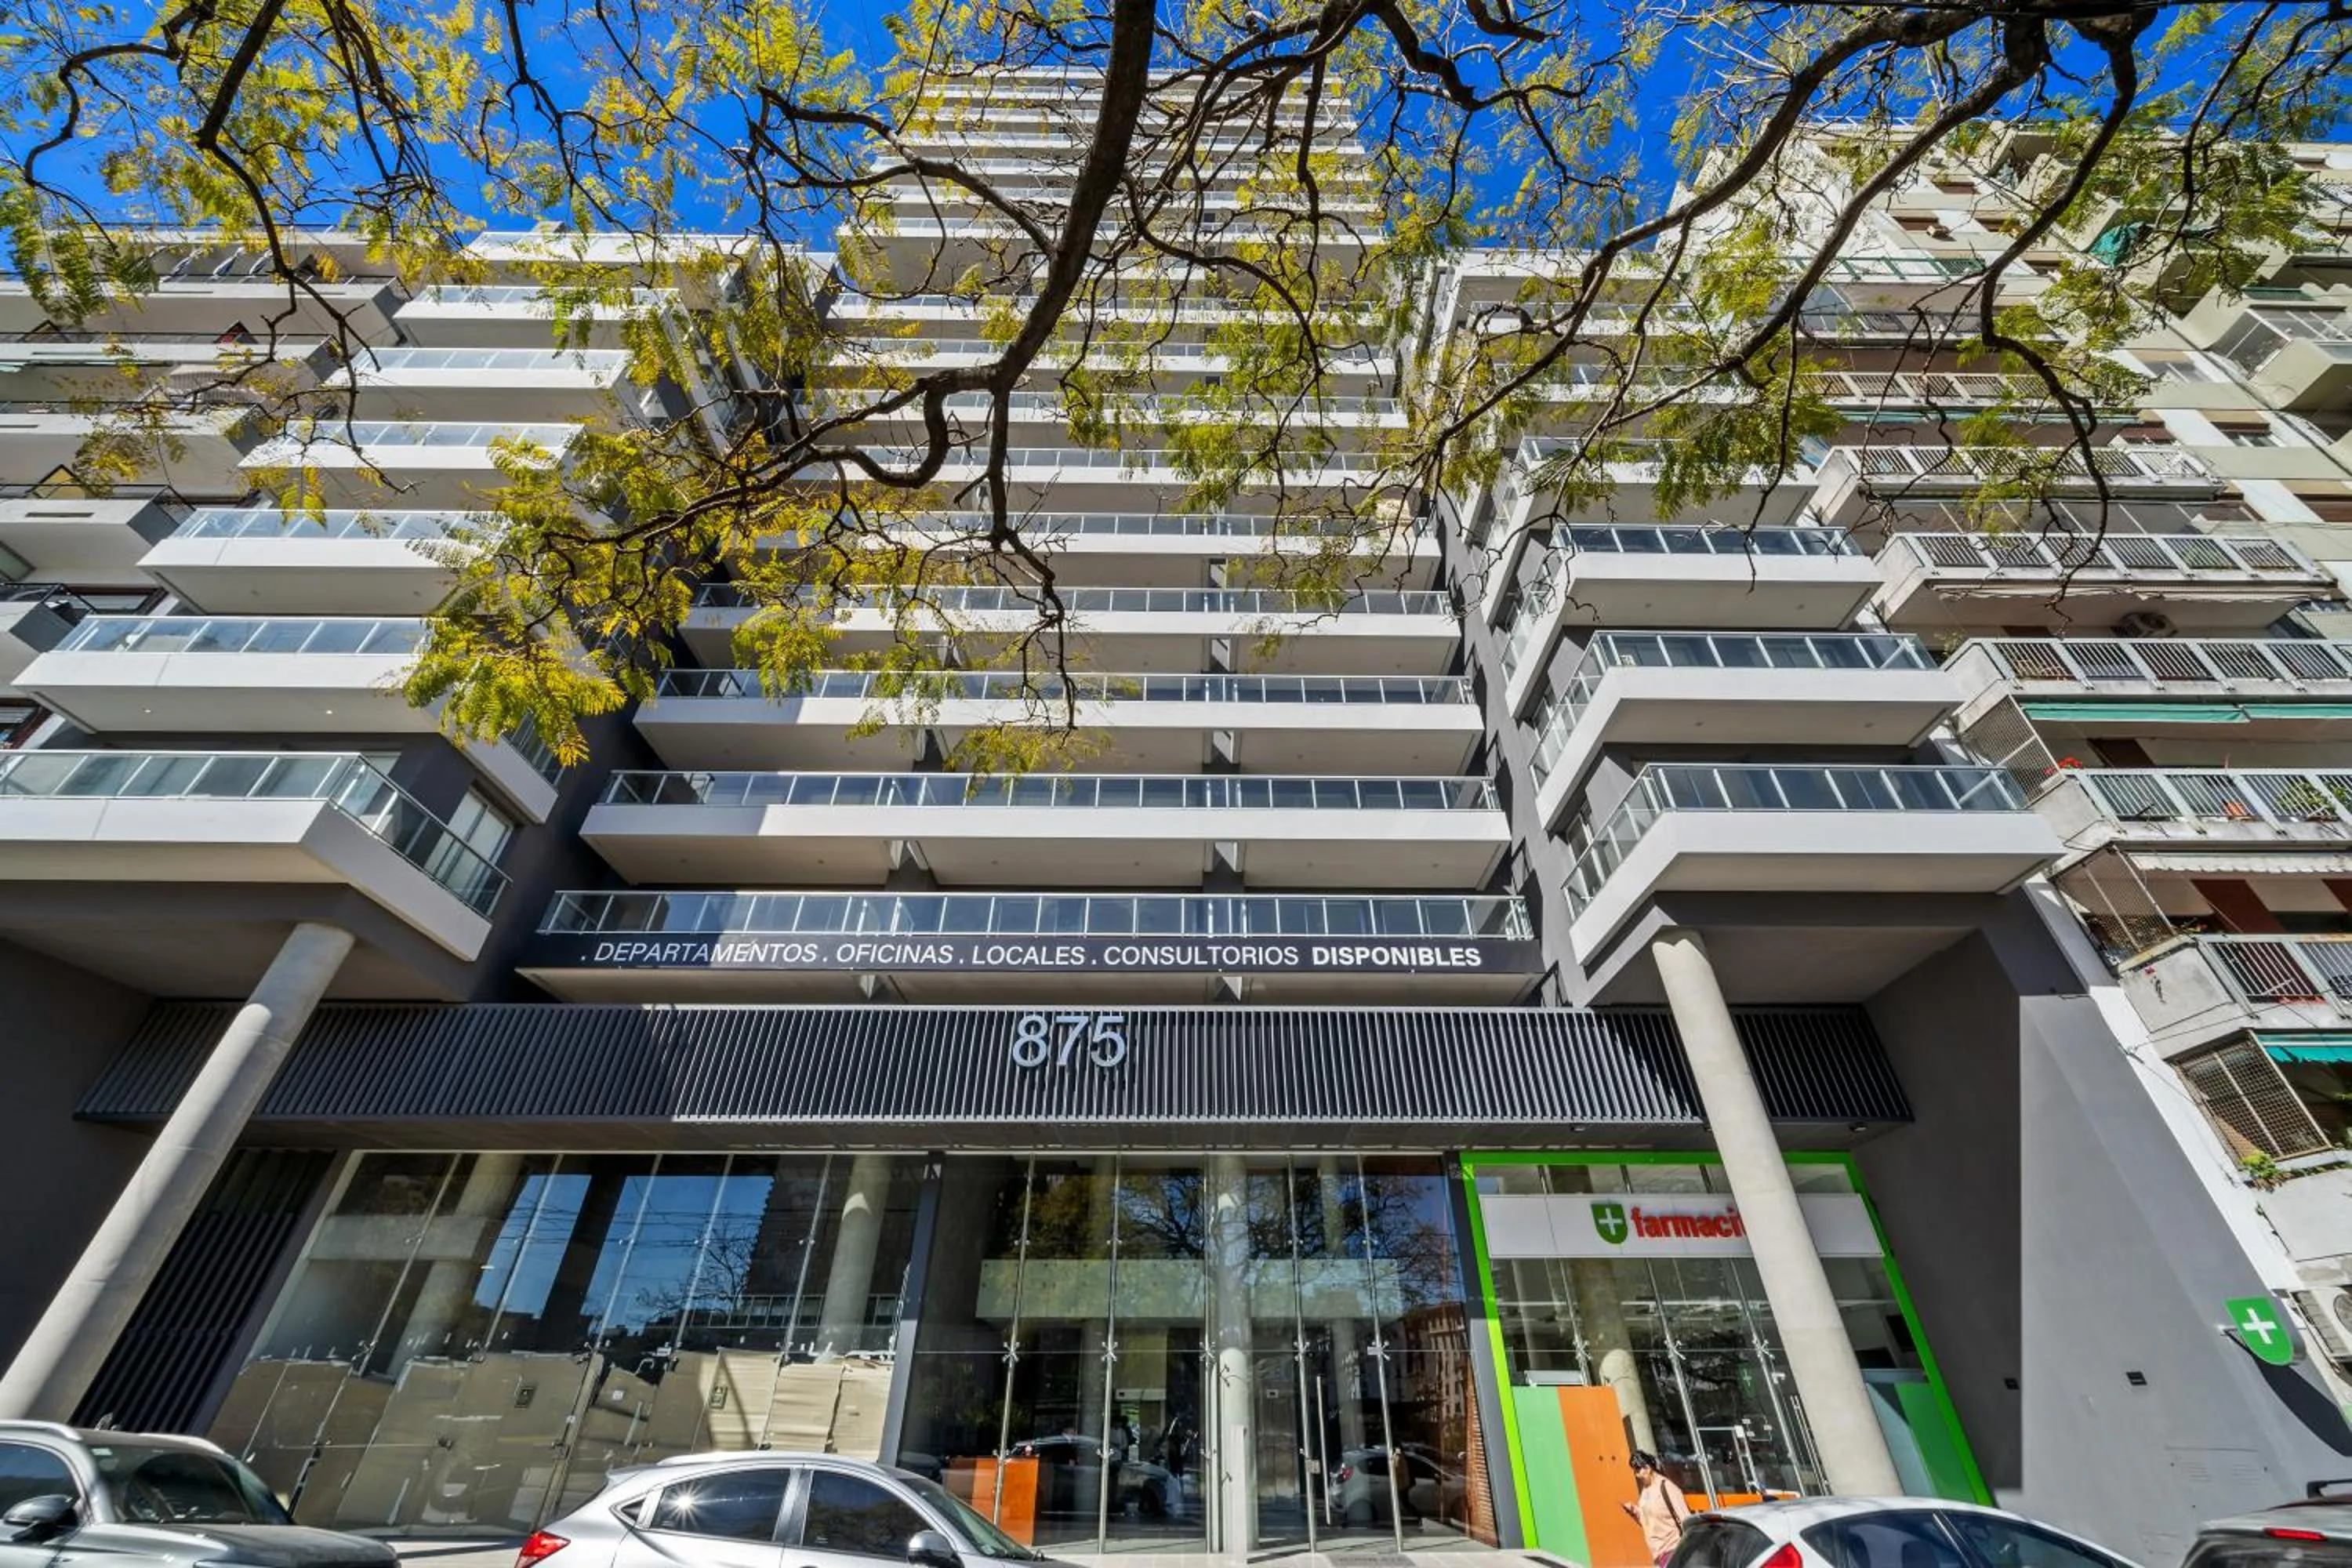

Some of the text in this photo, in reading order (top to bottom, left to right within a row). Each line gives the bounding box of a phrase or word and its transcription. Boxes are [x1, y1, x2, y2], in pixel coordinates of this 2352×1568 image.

[1312, 946, 1482, 967] DISPONIBLES
[1012, 1014, 1126, 1067] 875
[1631, 1206, 1747, 1238] farmaci
